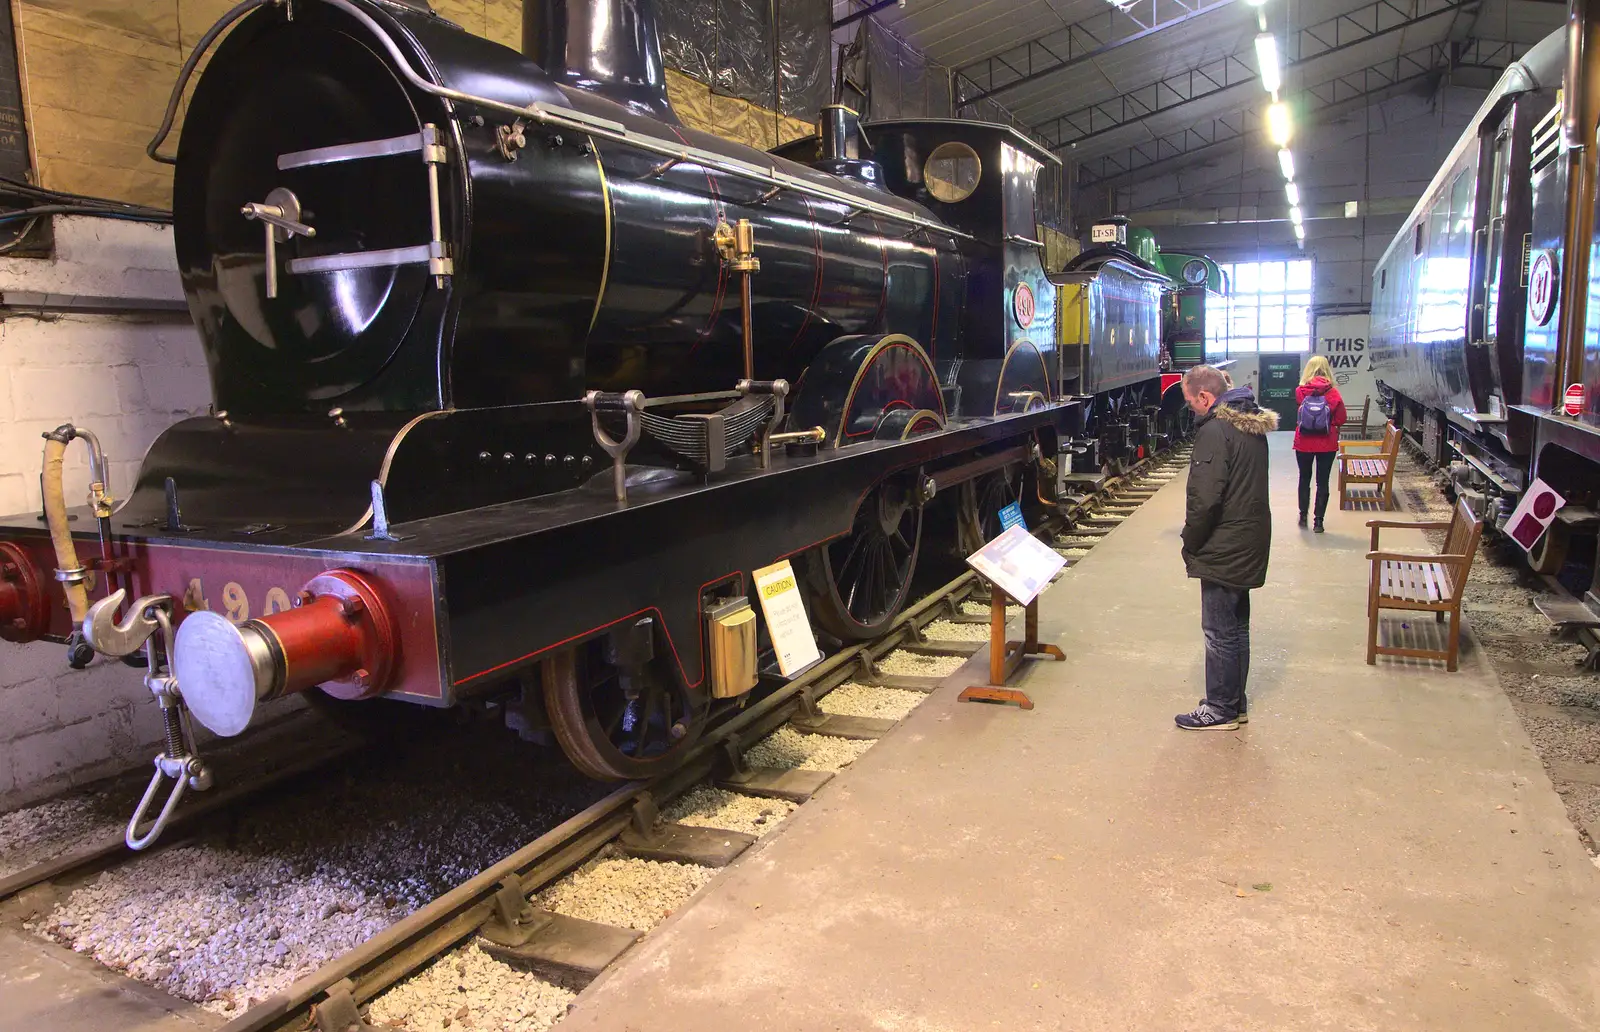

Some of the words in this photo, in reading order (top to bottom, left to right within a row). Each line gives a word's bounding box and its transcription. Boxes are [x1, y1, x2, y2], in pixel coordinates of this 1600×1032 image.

[1325, 338, 1364, 351] THIS
[1325, 354, 1363, 368] WAY
[766, 579, 792, 596] CAUTION
